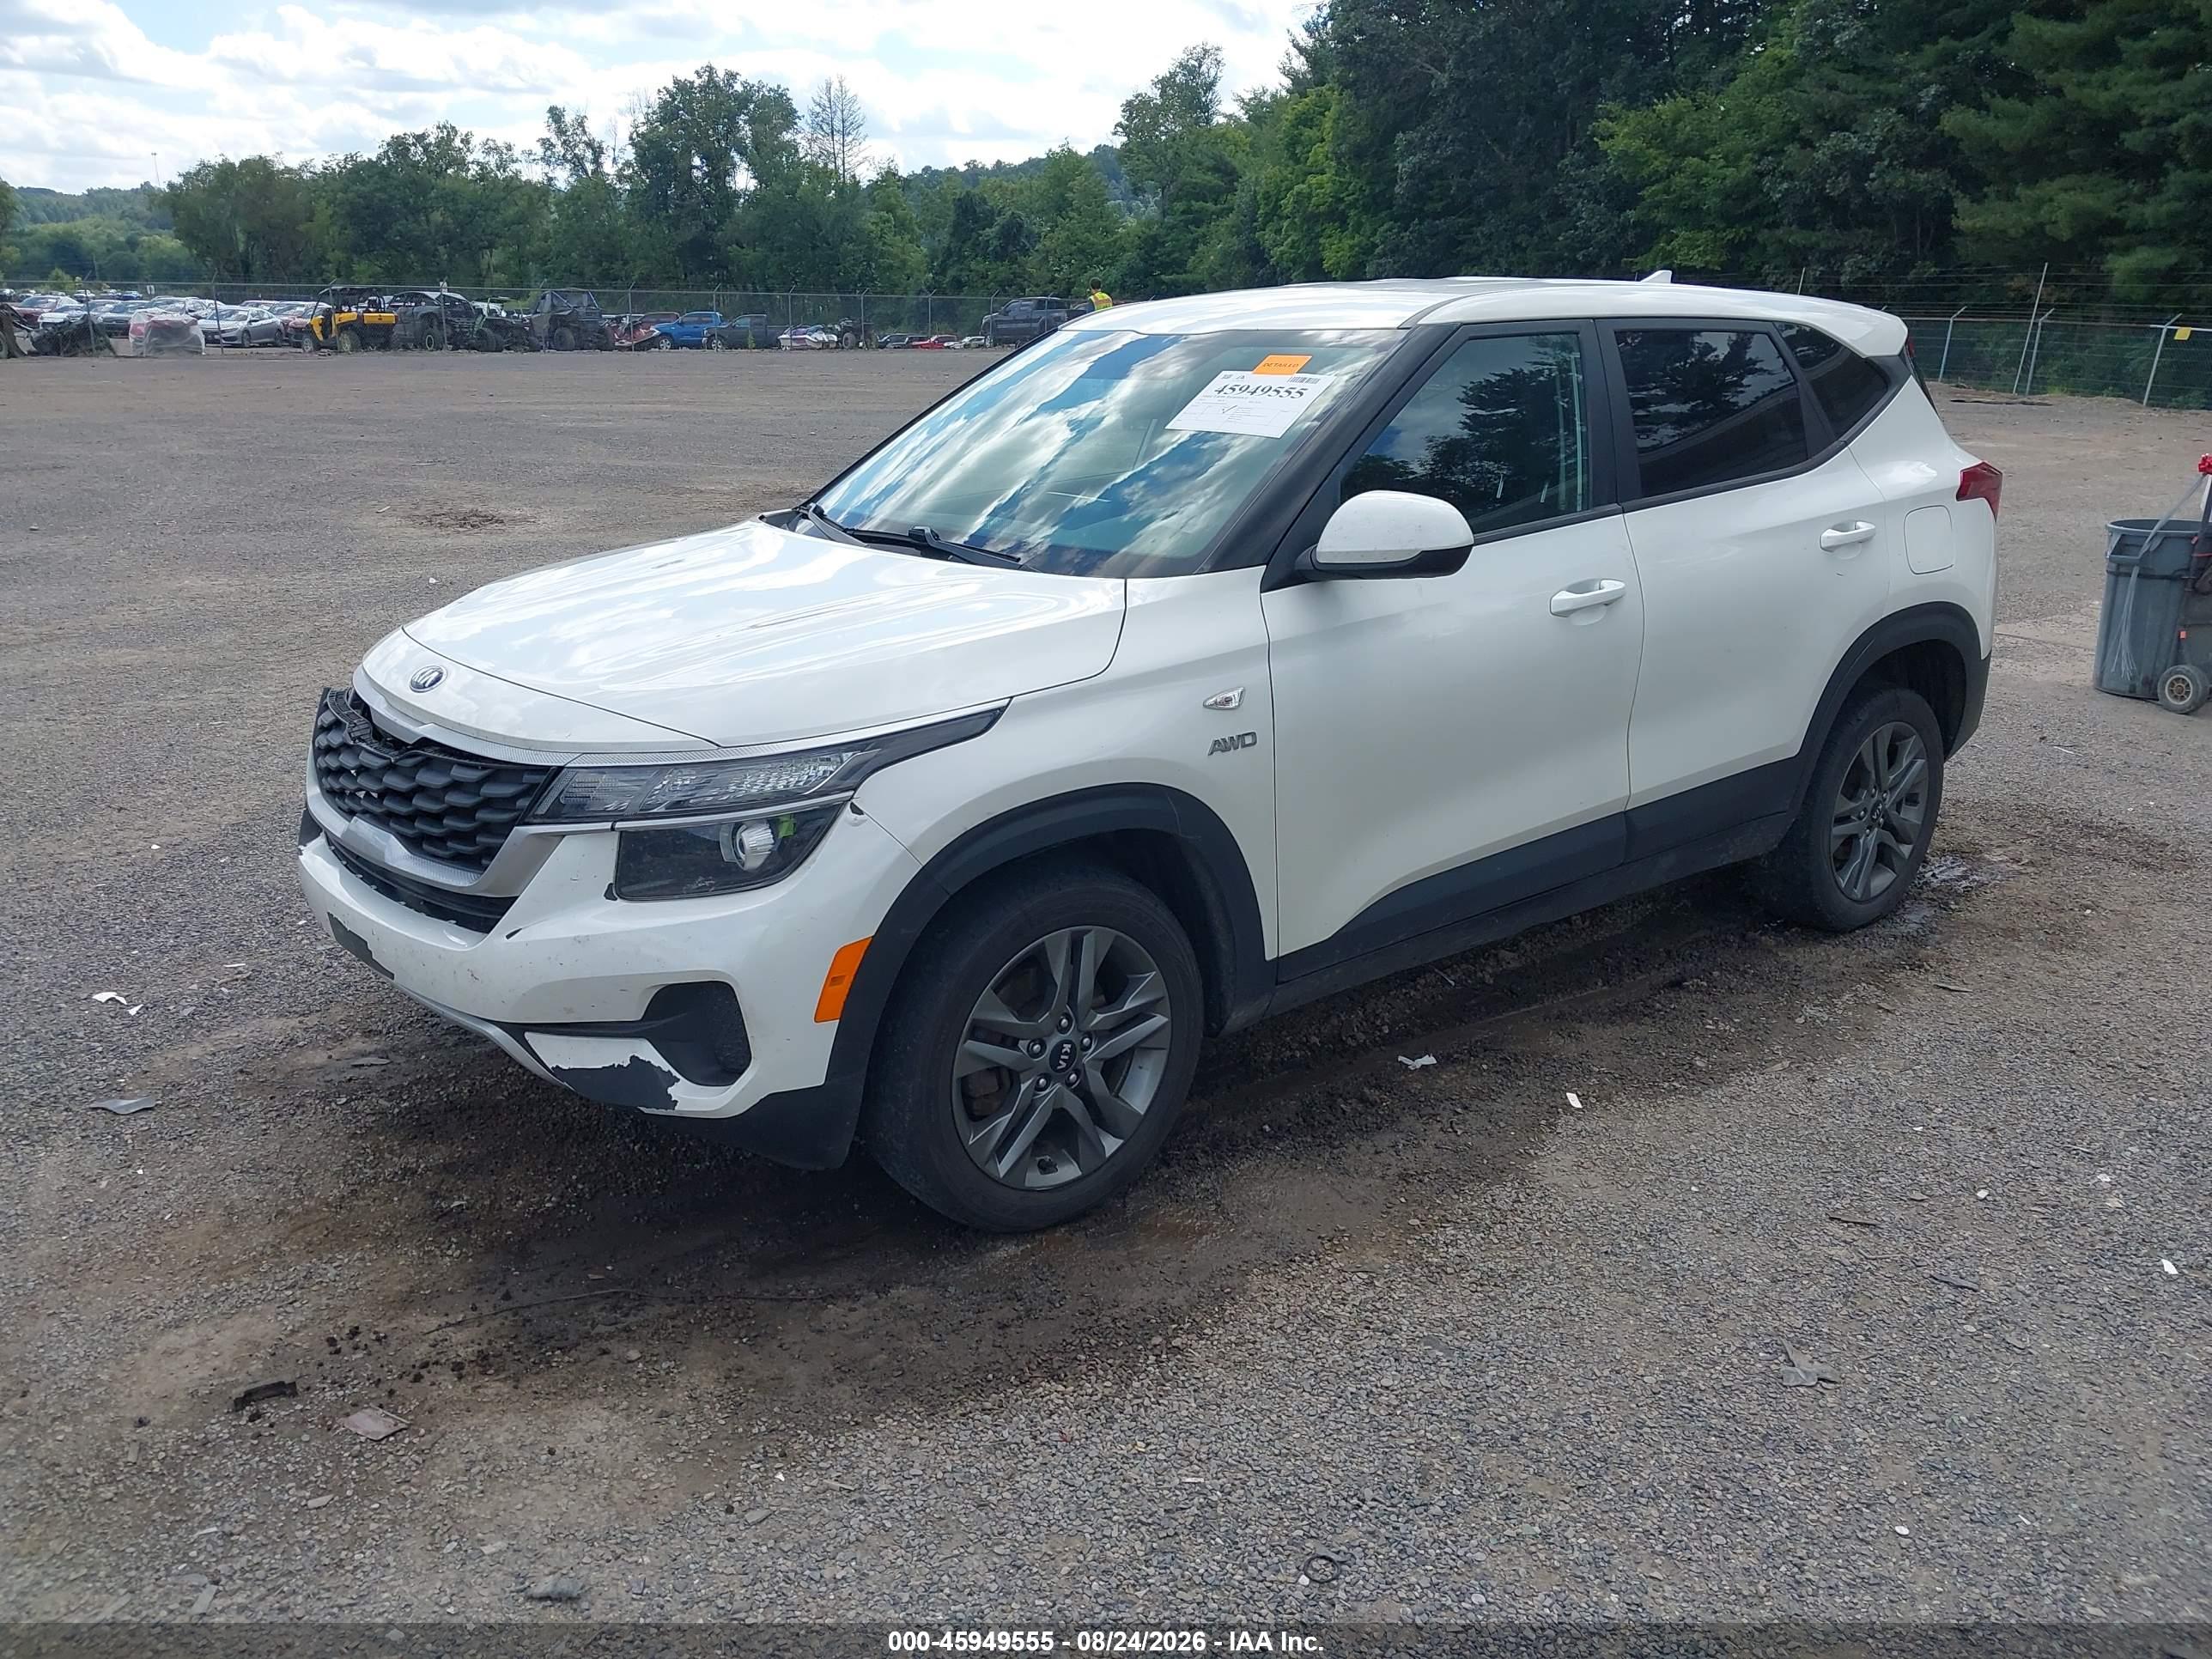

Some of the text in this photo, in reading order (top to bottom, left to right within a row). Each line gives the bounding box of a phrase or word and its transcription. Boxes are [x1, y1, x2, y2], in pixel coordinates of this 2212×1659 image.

[1214, 383, 1309, 399] 45949555
[1207, 731, 1257, 756] AWD
[1057, 1044, 1072, 1069] KIA
